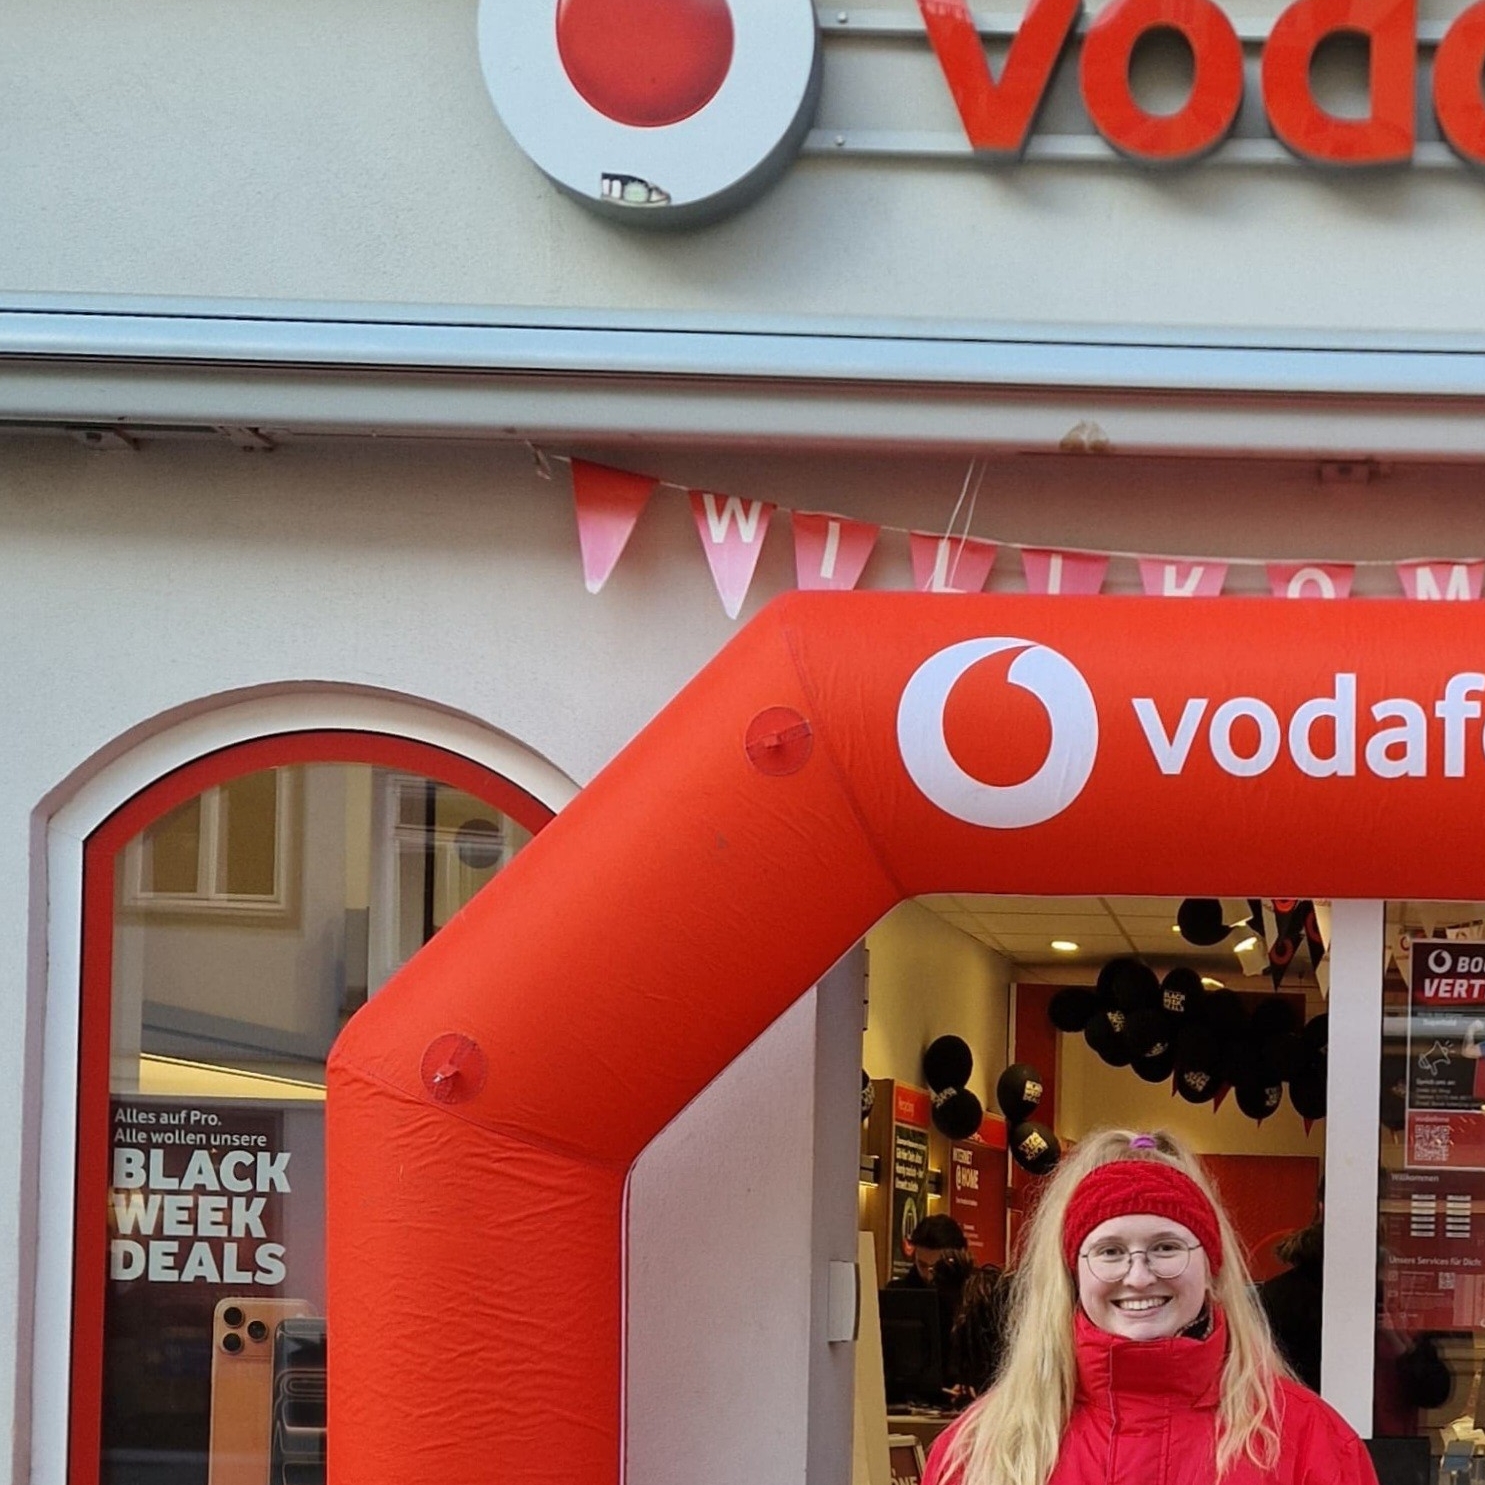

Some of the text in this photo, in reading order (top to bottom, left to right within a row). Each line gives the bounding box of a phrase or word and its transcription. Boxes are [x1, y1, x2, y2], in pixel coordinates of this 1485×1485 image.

[114, 1107, 222, 1126] Alles auf Pro.
[114, 1128, 267, 1147] Alle wollen unsere
[112, 1147, 292, 1193] BLACK
[113, 1193, 268, 1239] WEEK
[110, 1239, 287, 1286] DEALS
